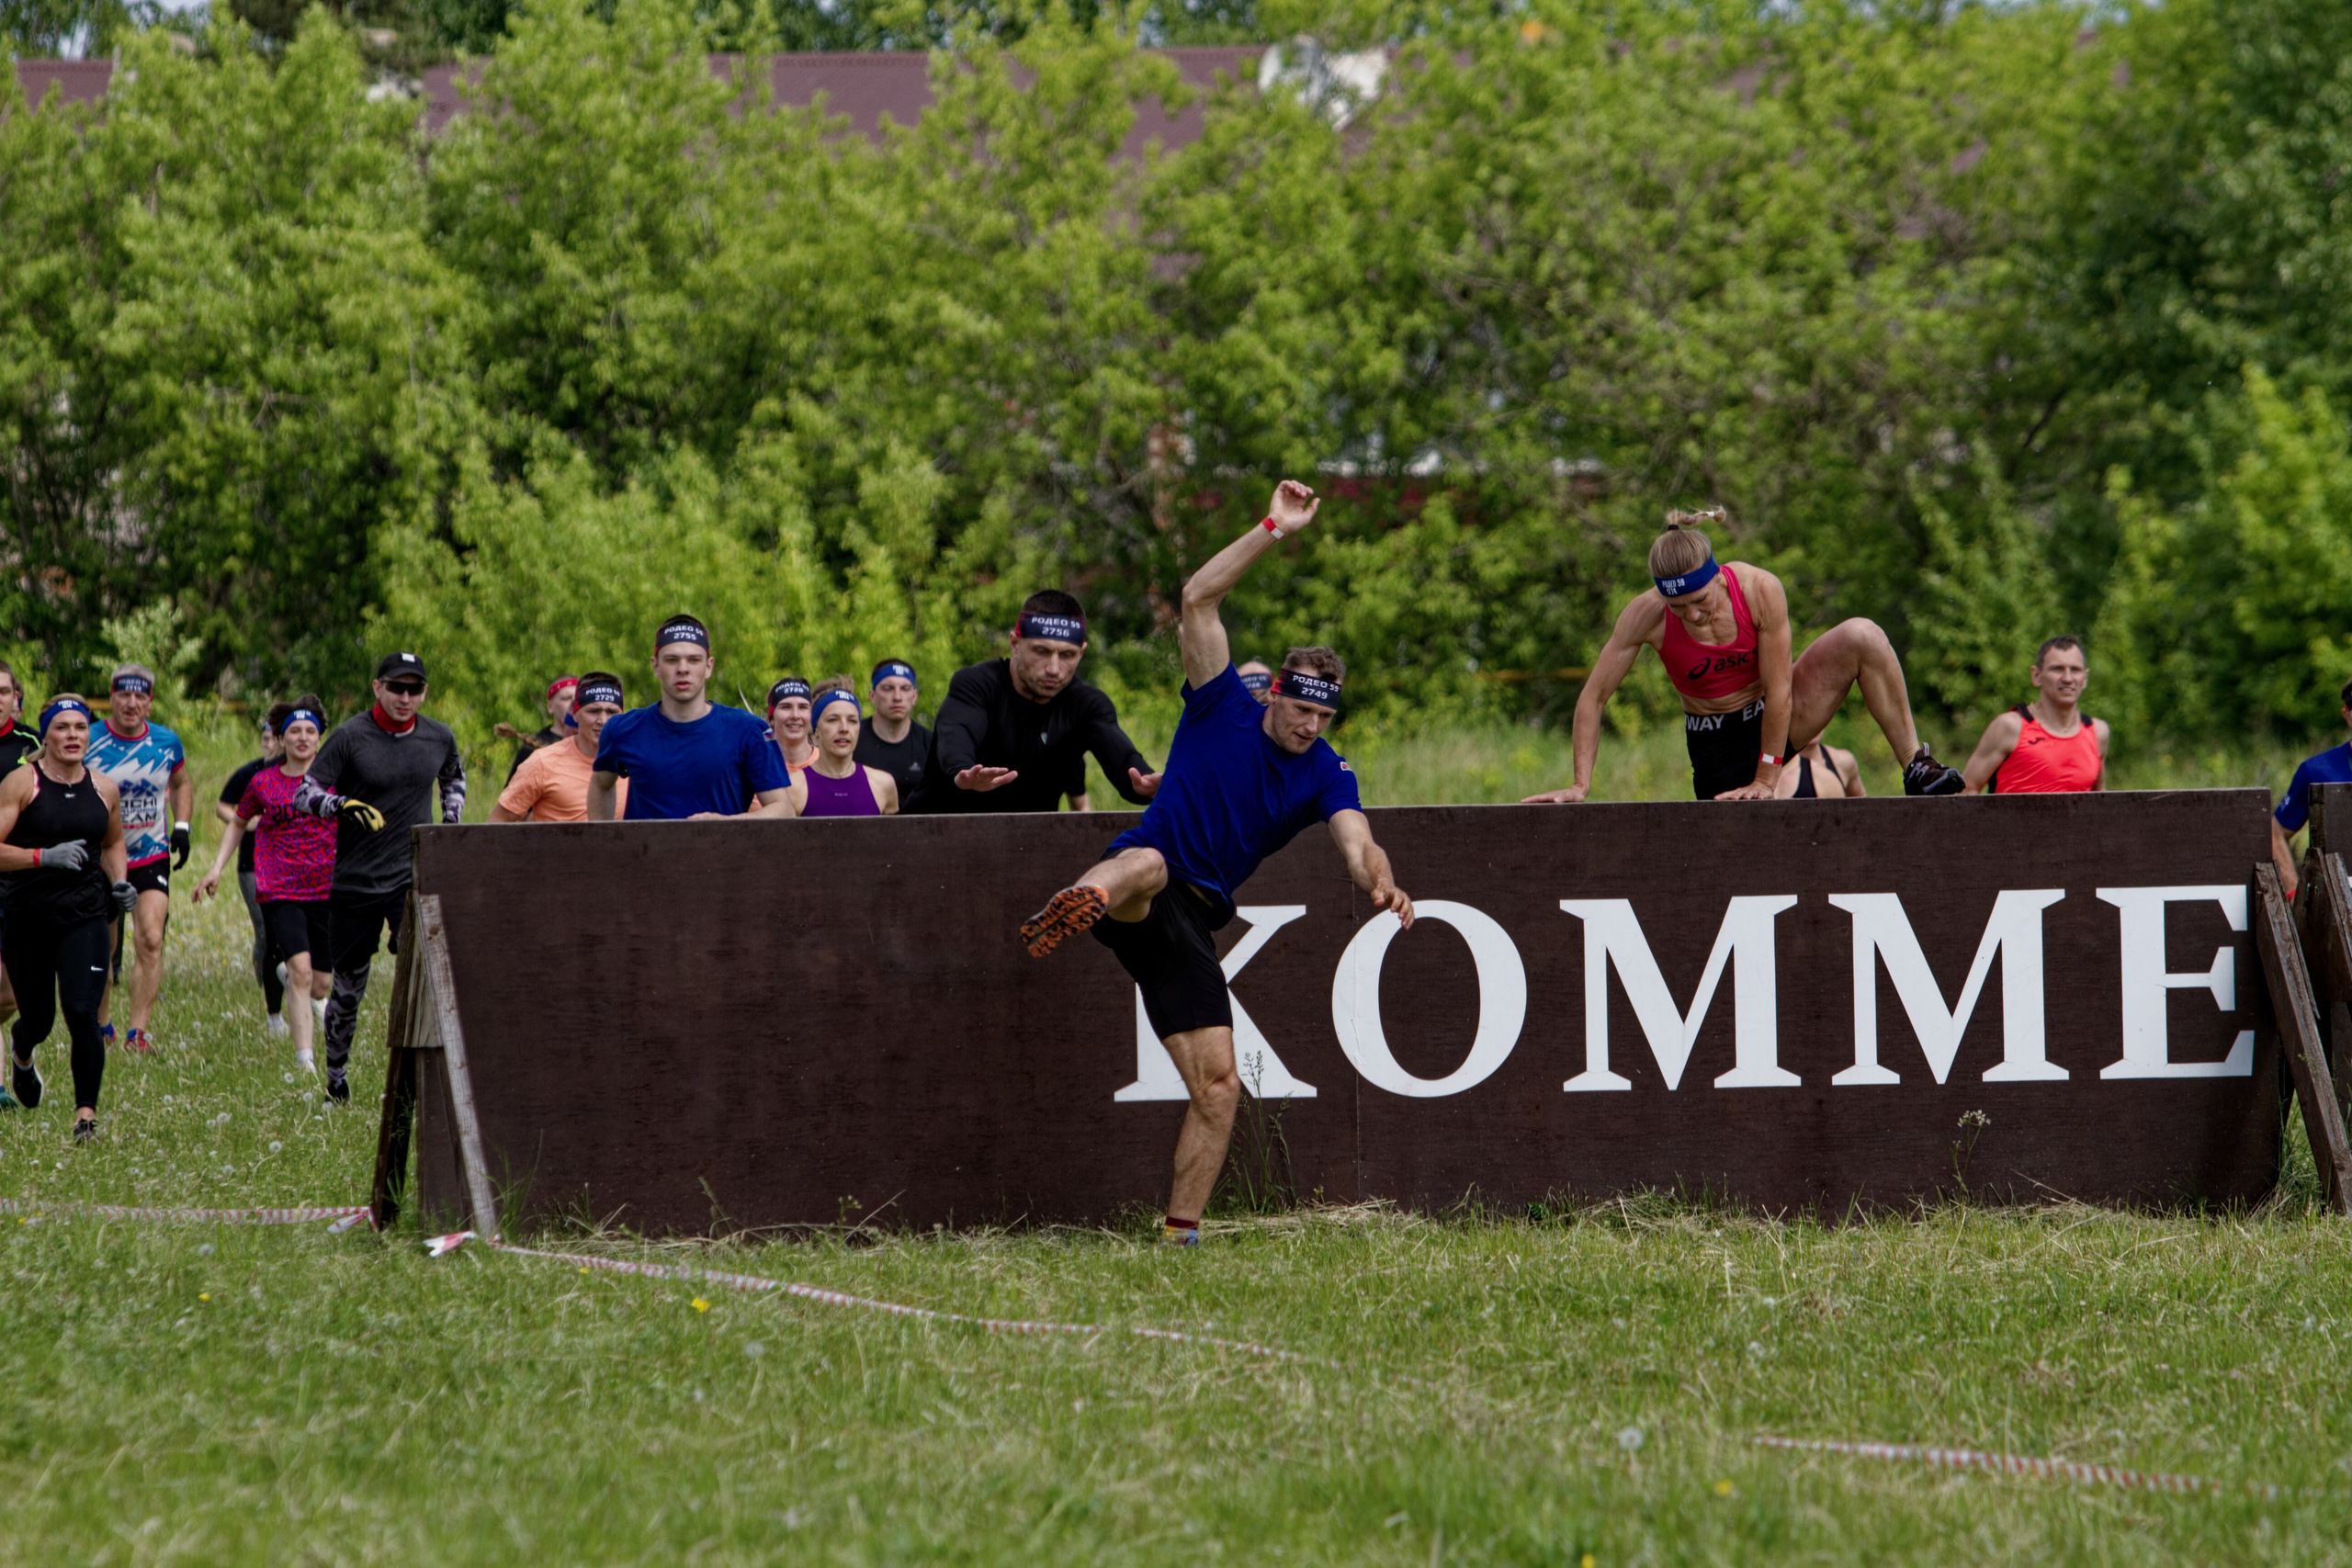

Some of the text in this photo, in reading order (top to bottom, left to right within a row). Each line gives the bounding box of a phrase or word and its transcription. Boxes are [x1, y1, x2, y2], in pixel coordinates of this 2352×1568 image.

[1677, 578, 1685, 588] 59
[1031, 616, 1080, 629] РОДЕО 59
[664, 625, 694, 635] РОДЕО
[1042, 626, 1070, 637] 2756
[673, 632, 696, 640] 2755
[1293, 675, 1340, 693] РОДЕО 59
[585, 687, 613, 695] РОДЕО
[1301, 687, 1328, 700] 2749
[594, 694, 615, 702] 2729
[1685, 714, 1724, 731] WAY
[120, 797, 157, 808] OCHI
[121, 812, 156, 823] EAM
